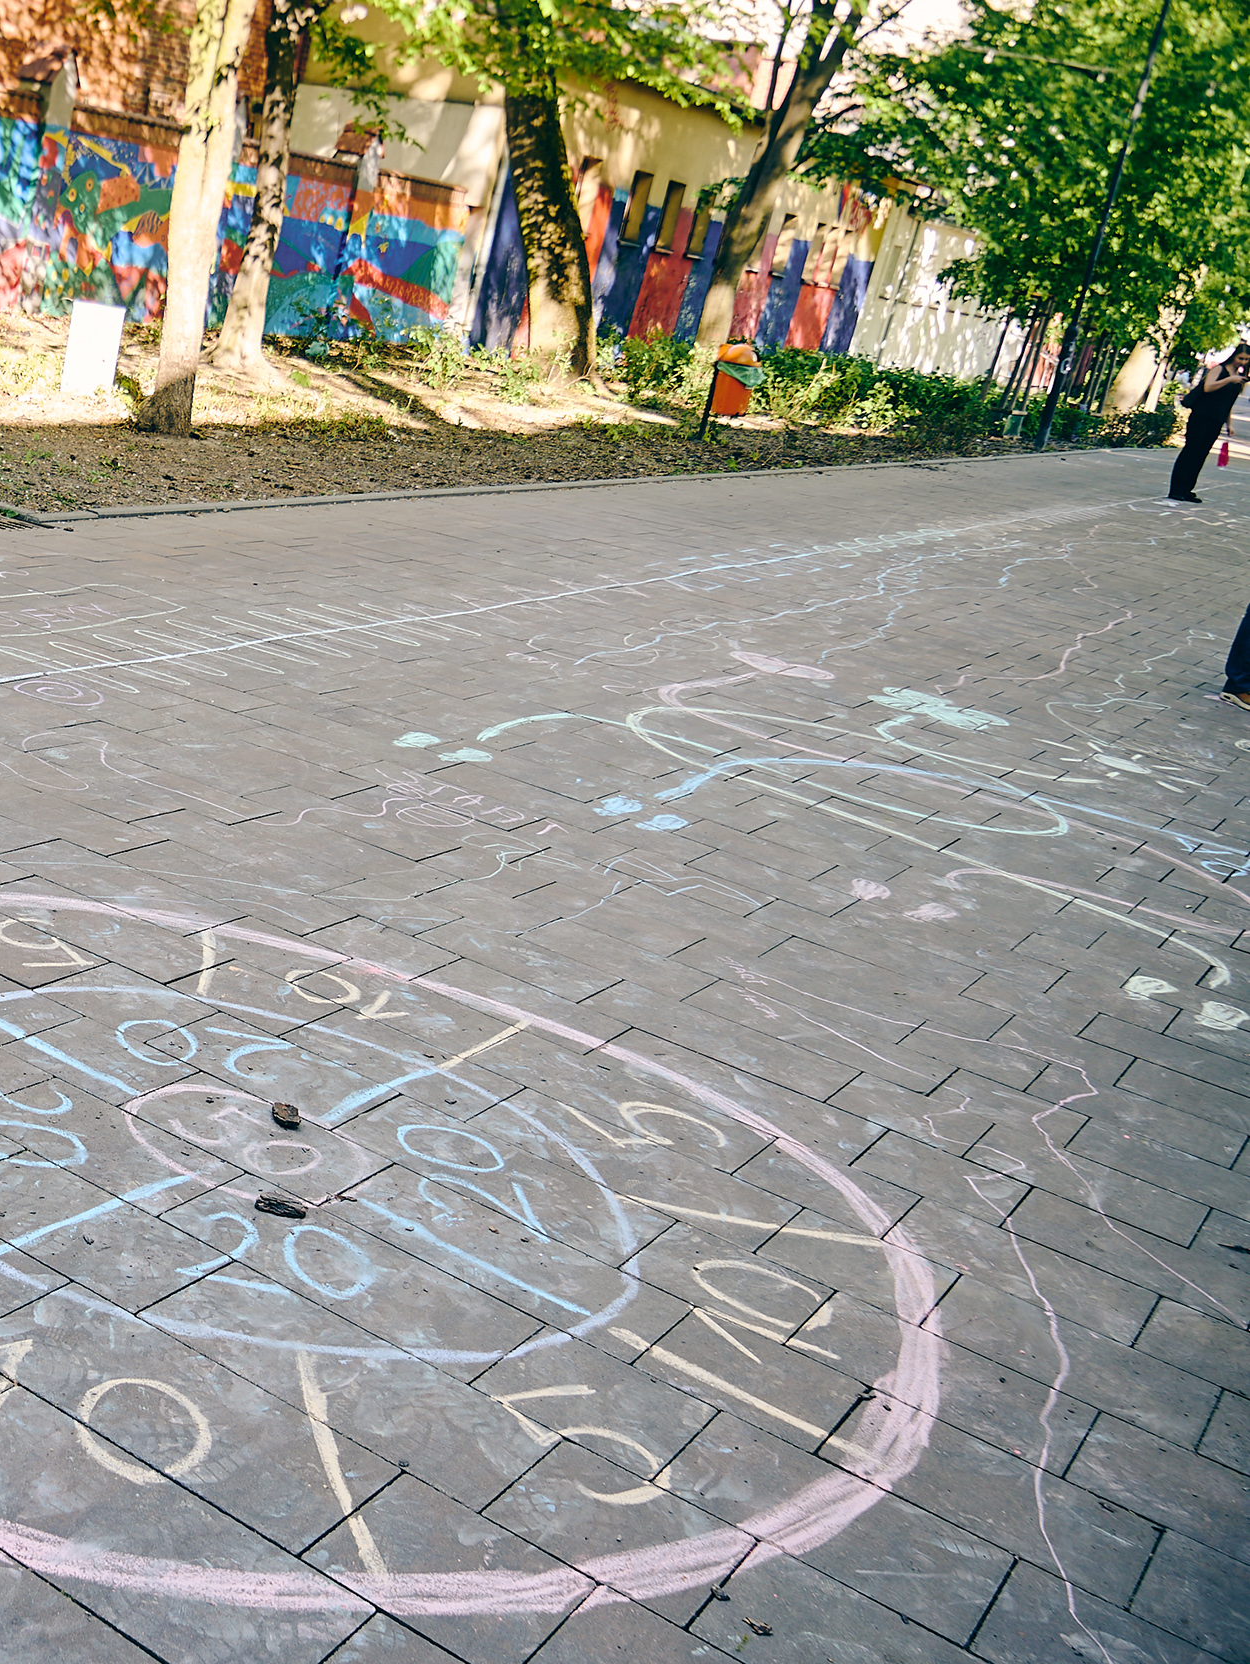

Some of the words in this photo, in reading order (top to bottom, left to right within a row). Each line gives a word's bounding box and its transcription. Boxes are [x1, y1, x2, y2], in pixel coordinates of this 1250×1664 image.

[114, 1017, 296, 1080] 20
[396, 1123, 550, 1245] 20
[175, 1212, 376, 1300] 20
[491, 1383, 673, 1506] 5
